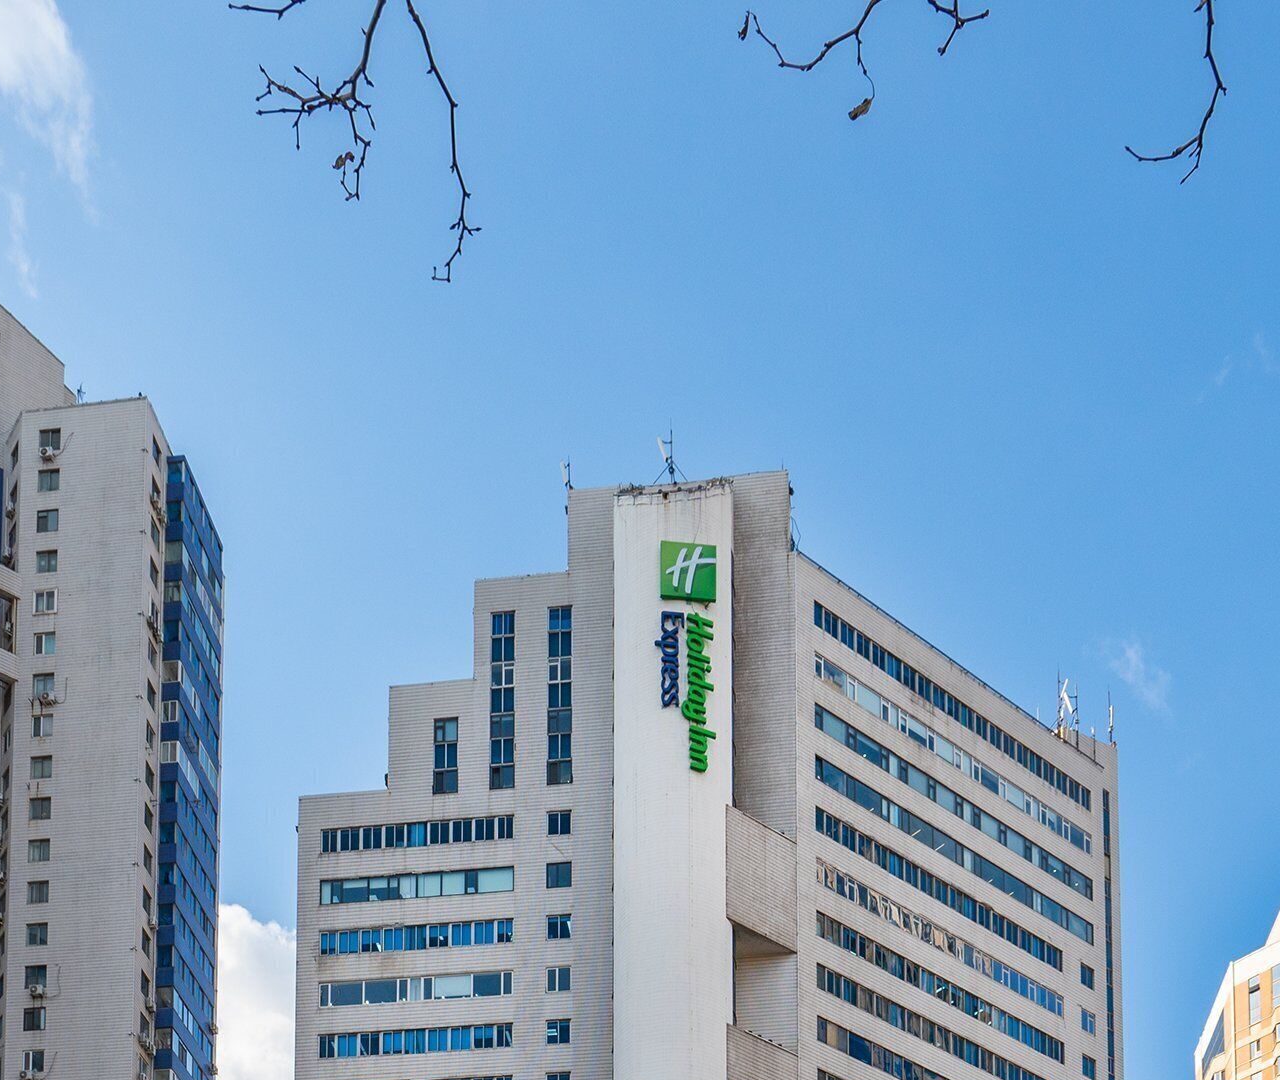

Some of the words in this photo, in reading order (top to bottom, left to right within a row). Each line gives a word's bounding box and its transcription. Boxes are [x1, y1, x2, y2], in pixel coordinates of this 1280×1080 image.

[654, 610, 684, 708] Express
[681, 612, 714, 725] Holiday
[689, 724, 716, 773] Inn
